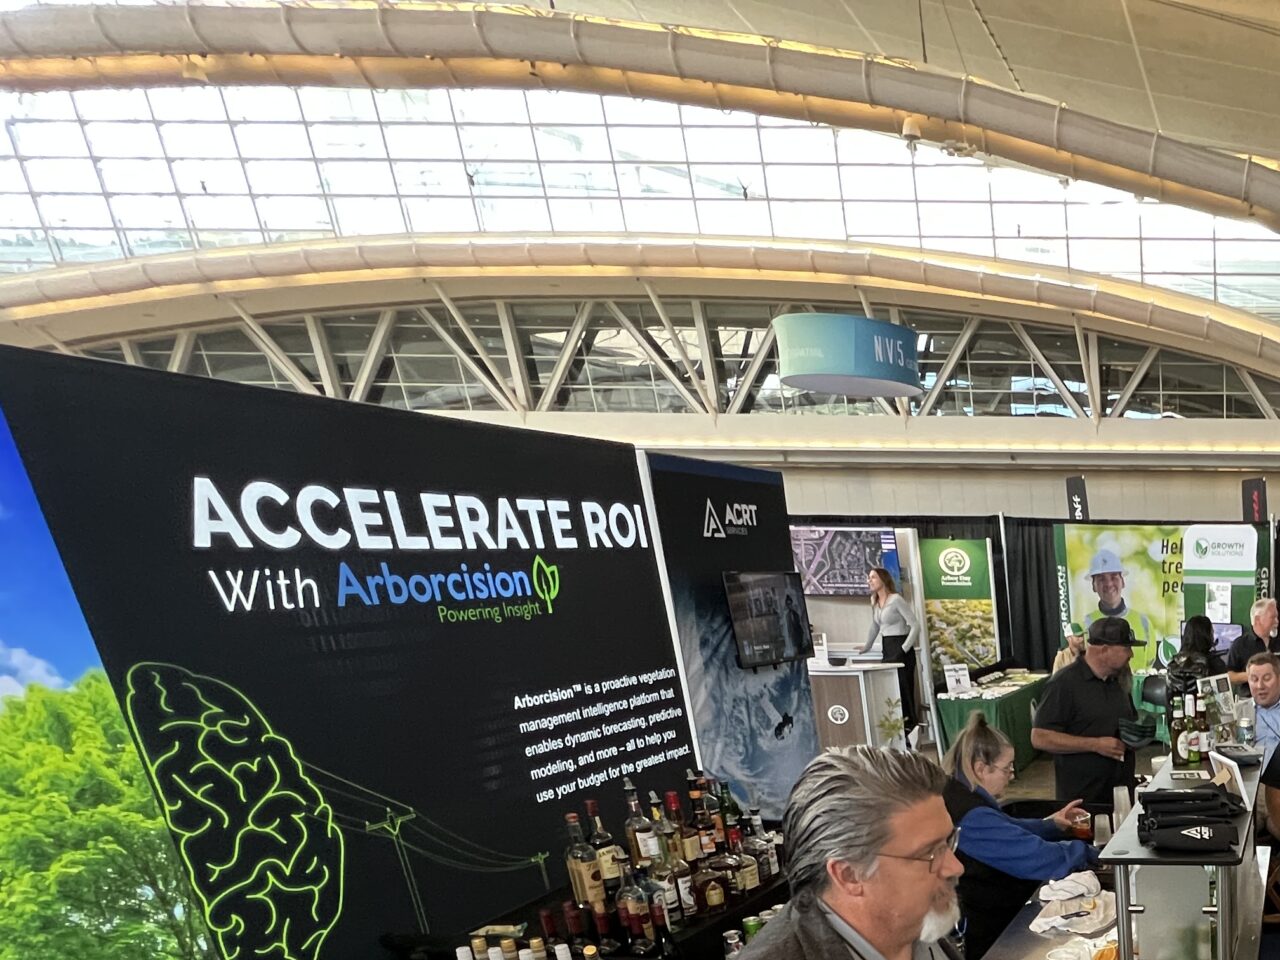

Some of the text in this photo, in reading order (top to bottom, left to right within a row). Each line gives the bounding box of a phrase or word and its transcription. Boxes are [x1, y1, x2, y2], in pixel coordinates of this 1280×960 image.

[193, 476, 649, 550] ACCELERATE ROI
[725, 503, 758, 527] ACRT
[1211, 542, 1245, 550] GROWTH
[208, 562, 533, 612] With Arborcision
[437, 600, 541, 624] Powering Insight
[584, 683, 593, 695] is
[594, 683, 600, 693] a
[602, 675, 638, 694] proactive
[638, 667, 676, 685] vegetation
[519, 687, 675, 734] management intelligence platform that
[525, 706, 683, 757] enables dynamic forecasting, predictive
[530, 758, 577, 781] modeling,
[578, 750, 596, 767] and
[596, 745, 618, 761] more
[626, 738, 636, 752] all
[637, 737, 645, 748] to
[645, 731, 662, 749] help
[662, 729, 677, 745] you
[536, 744, 692, 803] use your budget for the greatest impact.
